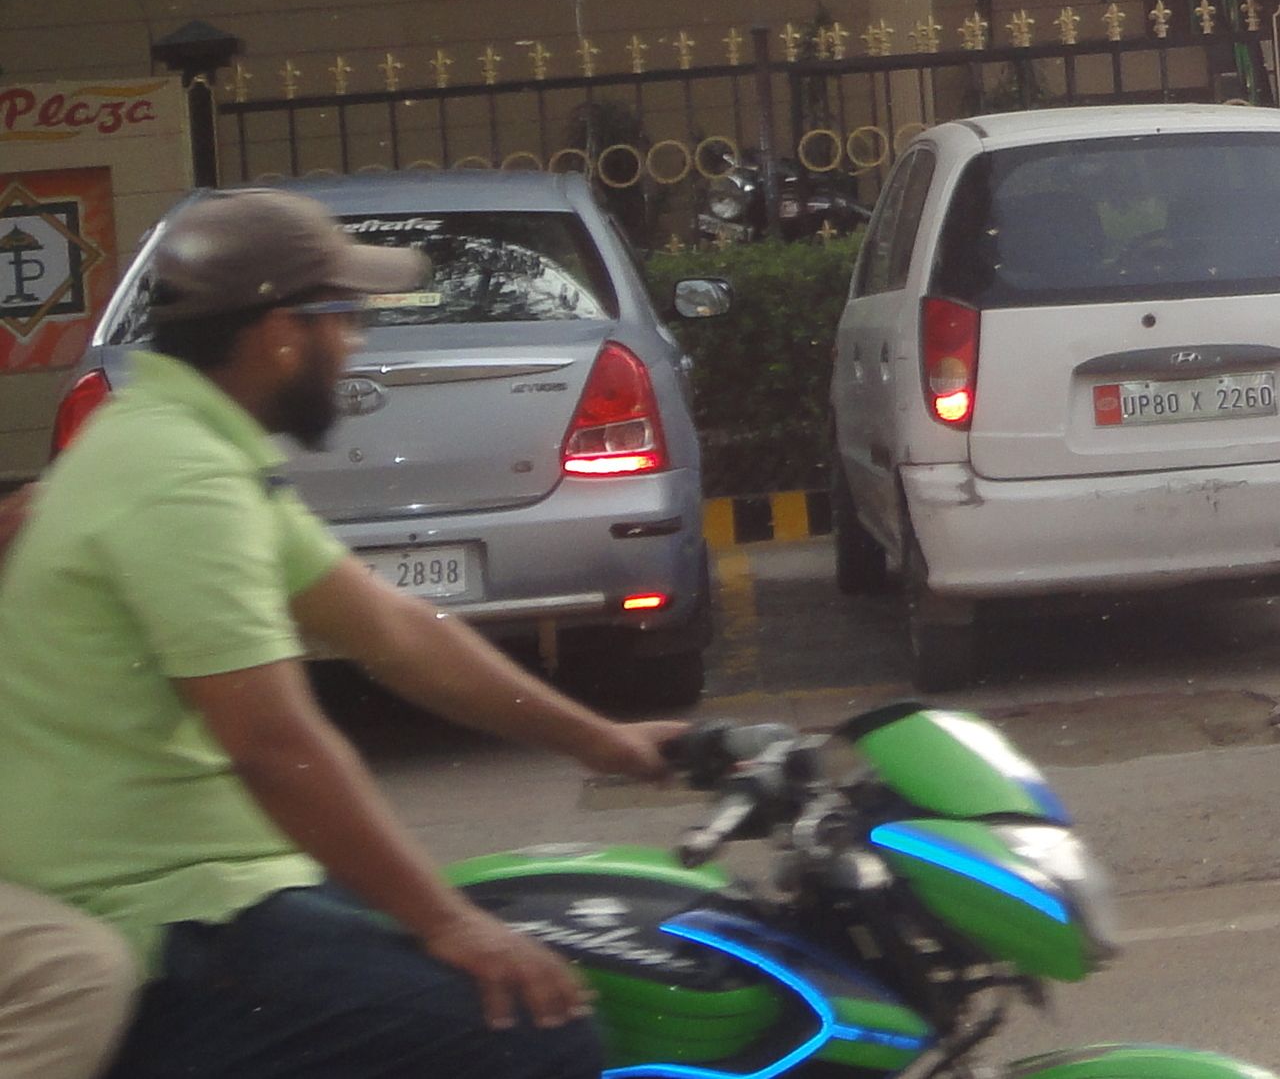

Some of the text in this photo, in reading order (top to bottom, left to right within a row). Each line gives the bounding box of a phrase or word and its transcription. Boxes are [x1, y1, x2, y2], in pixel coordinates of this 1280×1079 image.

[0, 88, 158, 134] Plaza
[1122, 385, 1273, 417] UP80 X 2260
[397, 559, 459, 587] 2898
